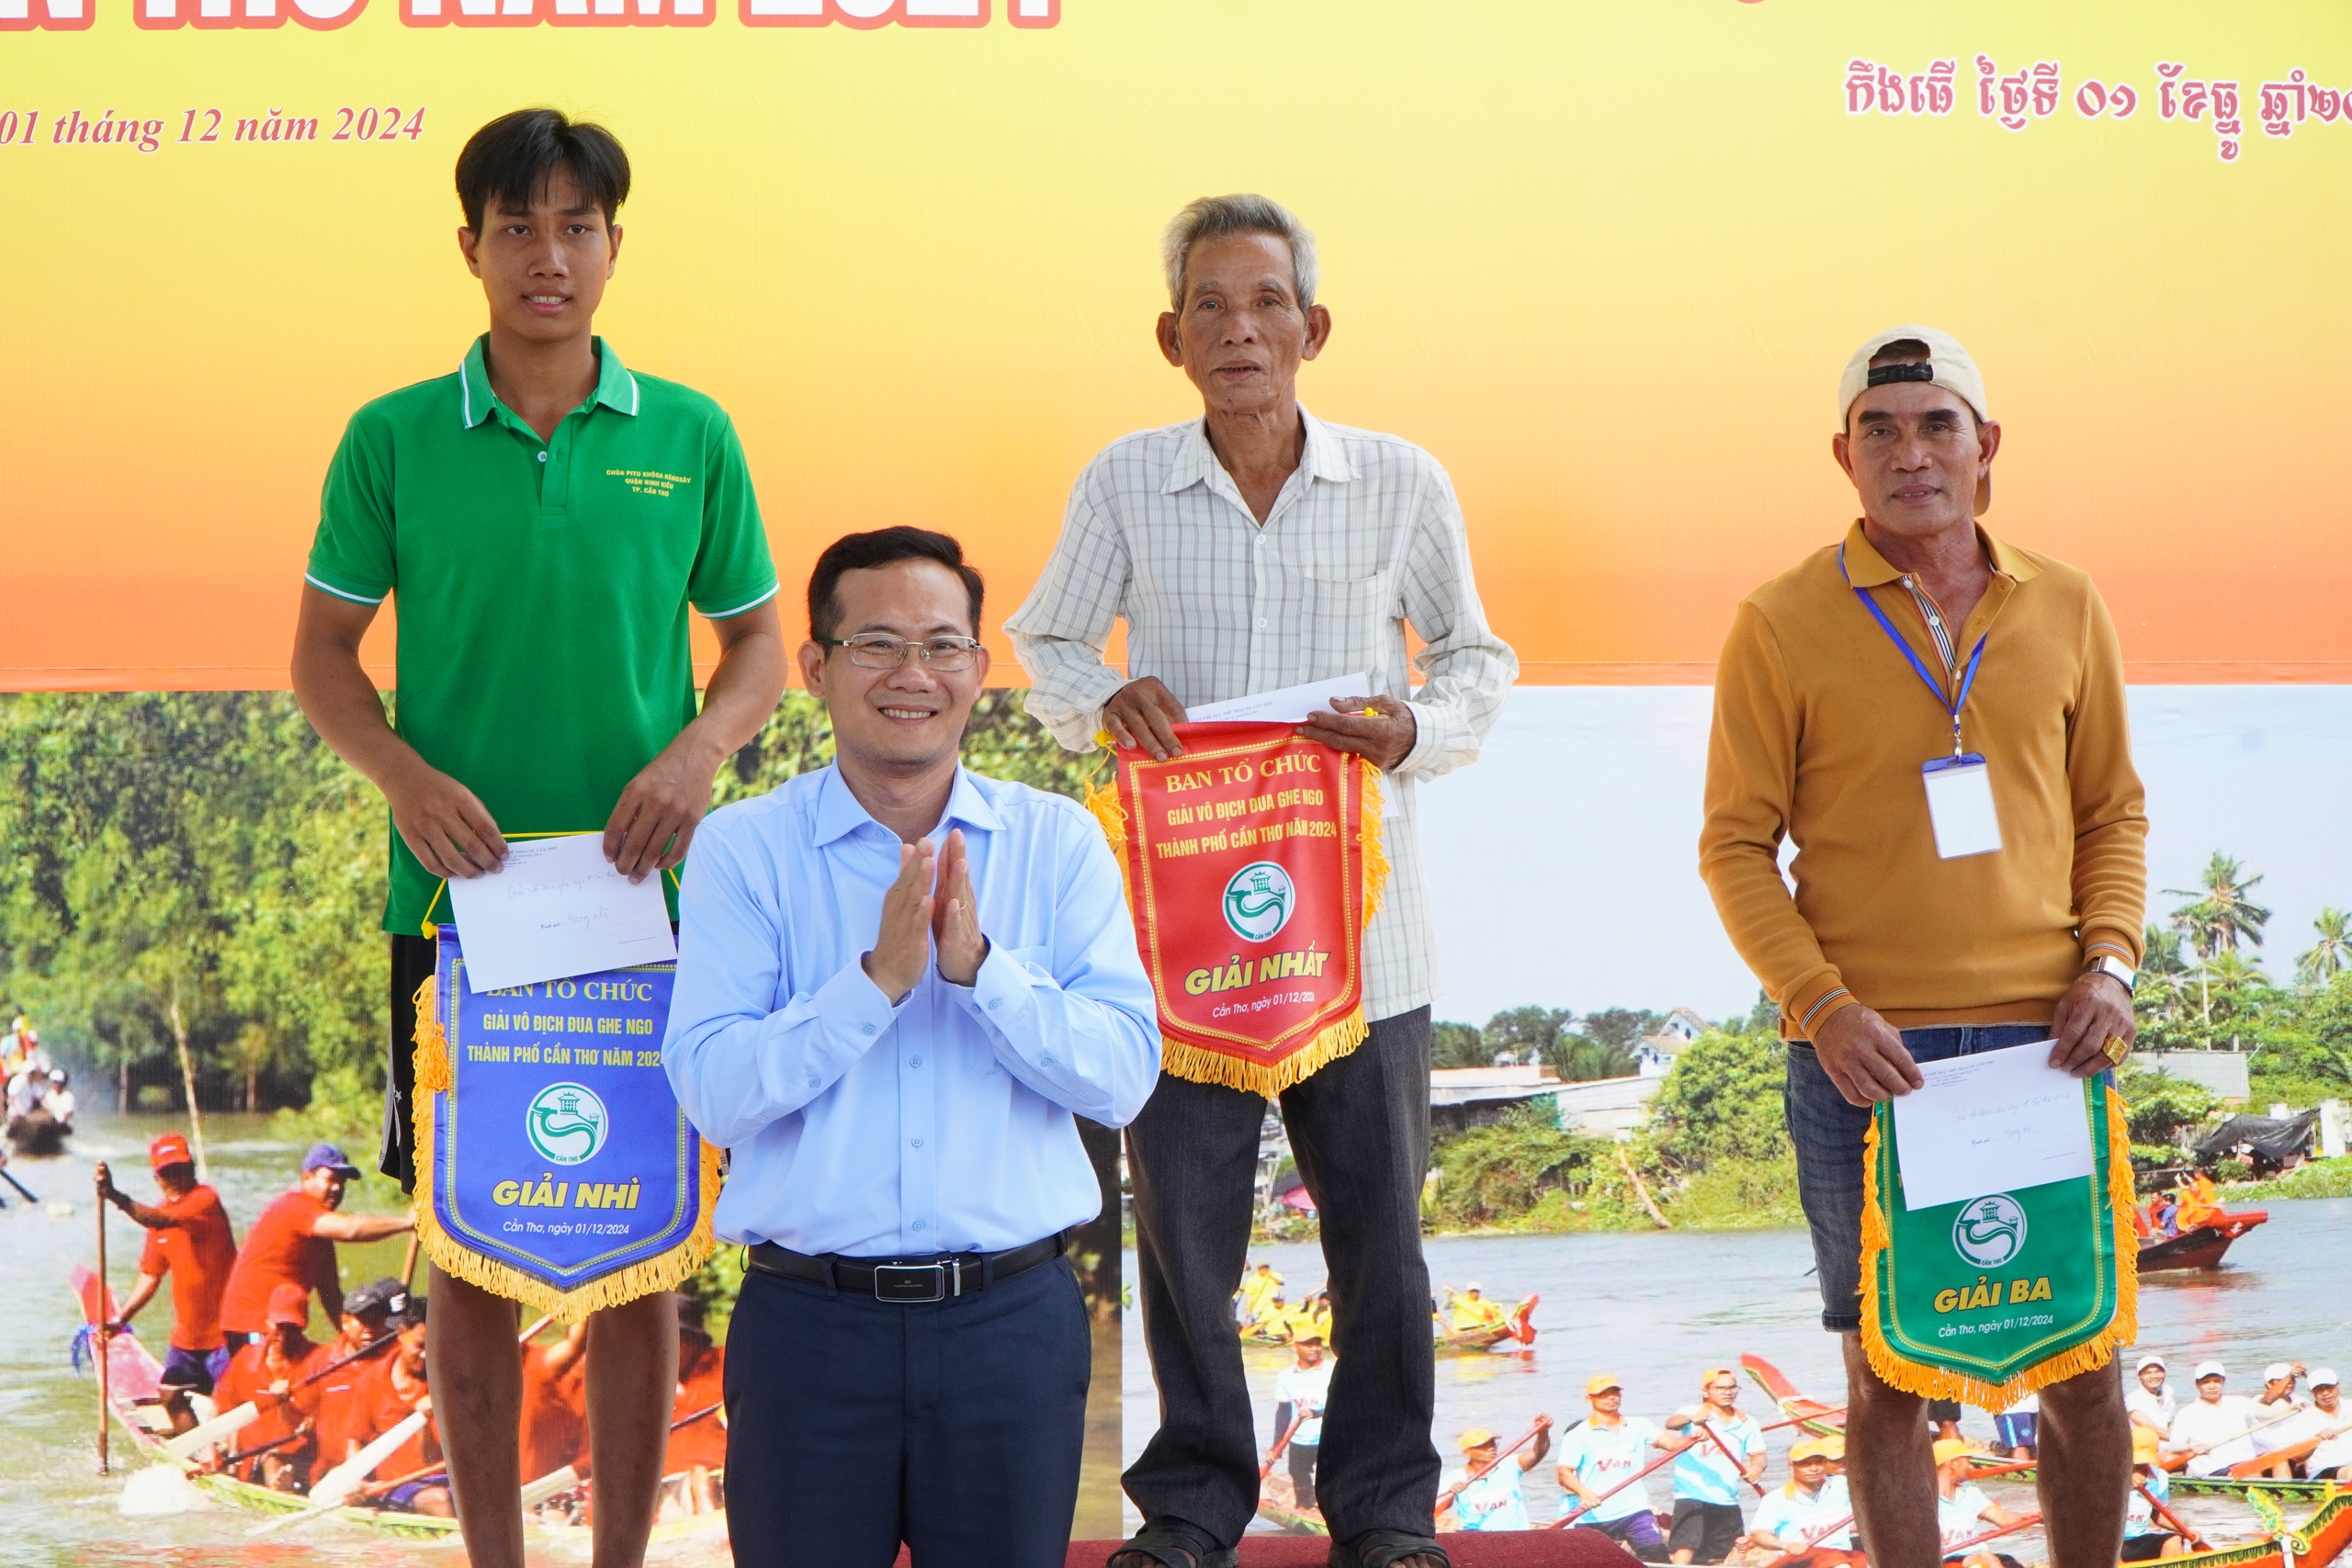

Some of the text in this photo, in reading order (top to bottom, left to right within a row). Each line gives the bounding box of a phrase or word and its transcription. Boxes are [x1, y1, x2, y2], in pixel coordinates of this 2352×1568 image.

[0, 107, 426, 152] 01 tháng 12 năm 2024
[1165, 750, 1321, 793] BAN TỔ CHỨC
[1168, 789, 1323, 826] GIẢI VÔ ĐỊCH ĐUA GHE NGO
[1156, 817, 1337, 859] THÀNH PHỐ CẦN THƠ NĂM 2024
[1184, 939, 1330, 996] GIẢI NHẤT
[583, 979, 652, 1001] CHỨC
[1213, 1003, 1231, 1018] Cần
[1233, 1004, 1249, 1015] Thơ,
[1251, 997, 1270, 1012] ngày
[483, 1009, 653, 1036] GIẢI VÔ ĐỊCH ĐUA GHE NGO
[468, 1042, 666, 1067] THÀNH PHỐ CẦN THƠ NĂM 202
[492, 1172, 641, 1210] GIẢI NHÌ
[503, 1218, 629, 1235] Cần Thơ, ngày 01/12/2024
[1933, 1274, 2053, 1314] GIẢI BA
[1939, 1314, 2053, 1338] Cần Thơ, ngày 01/12/2024
